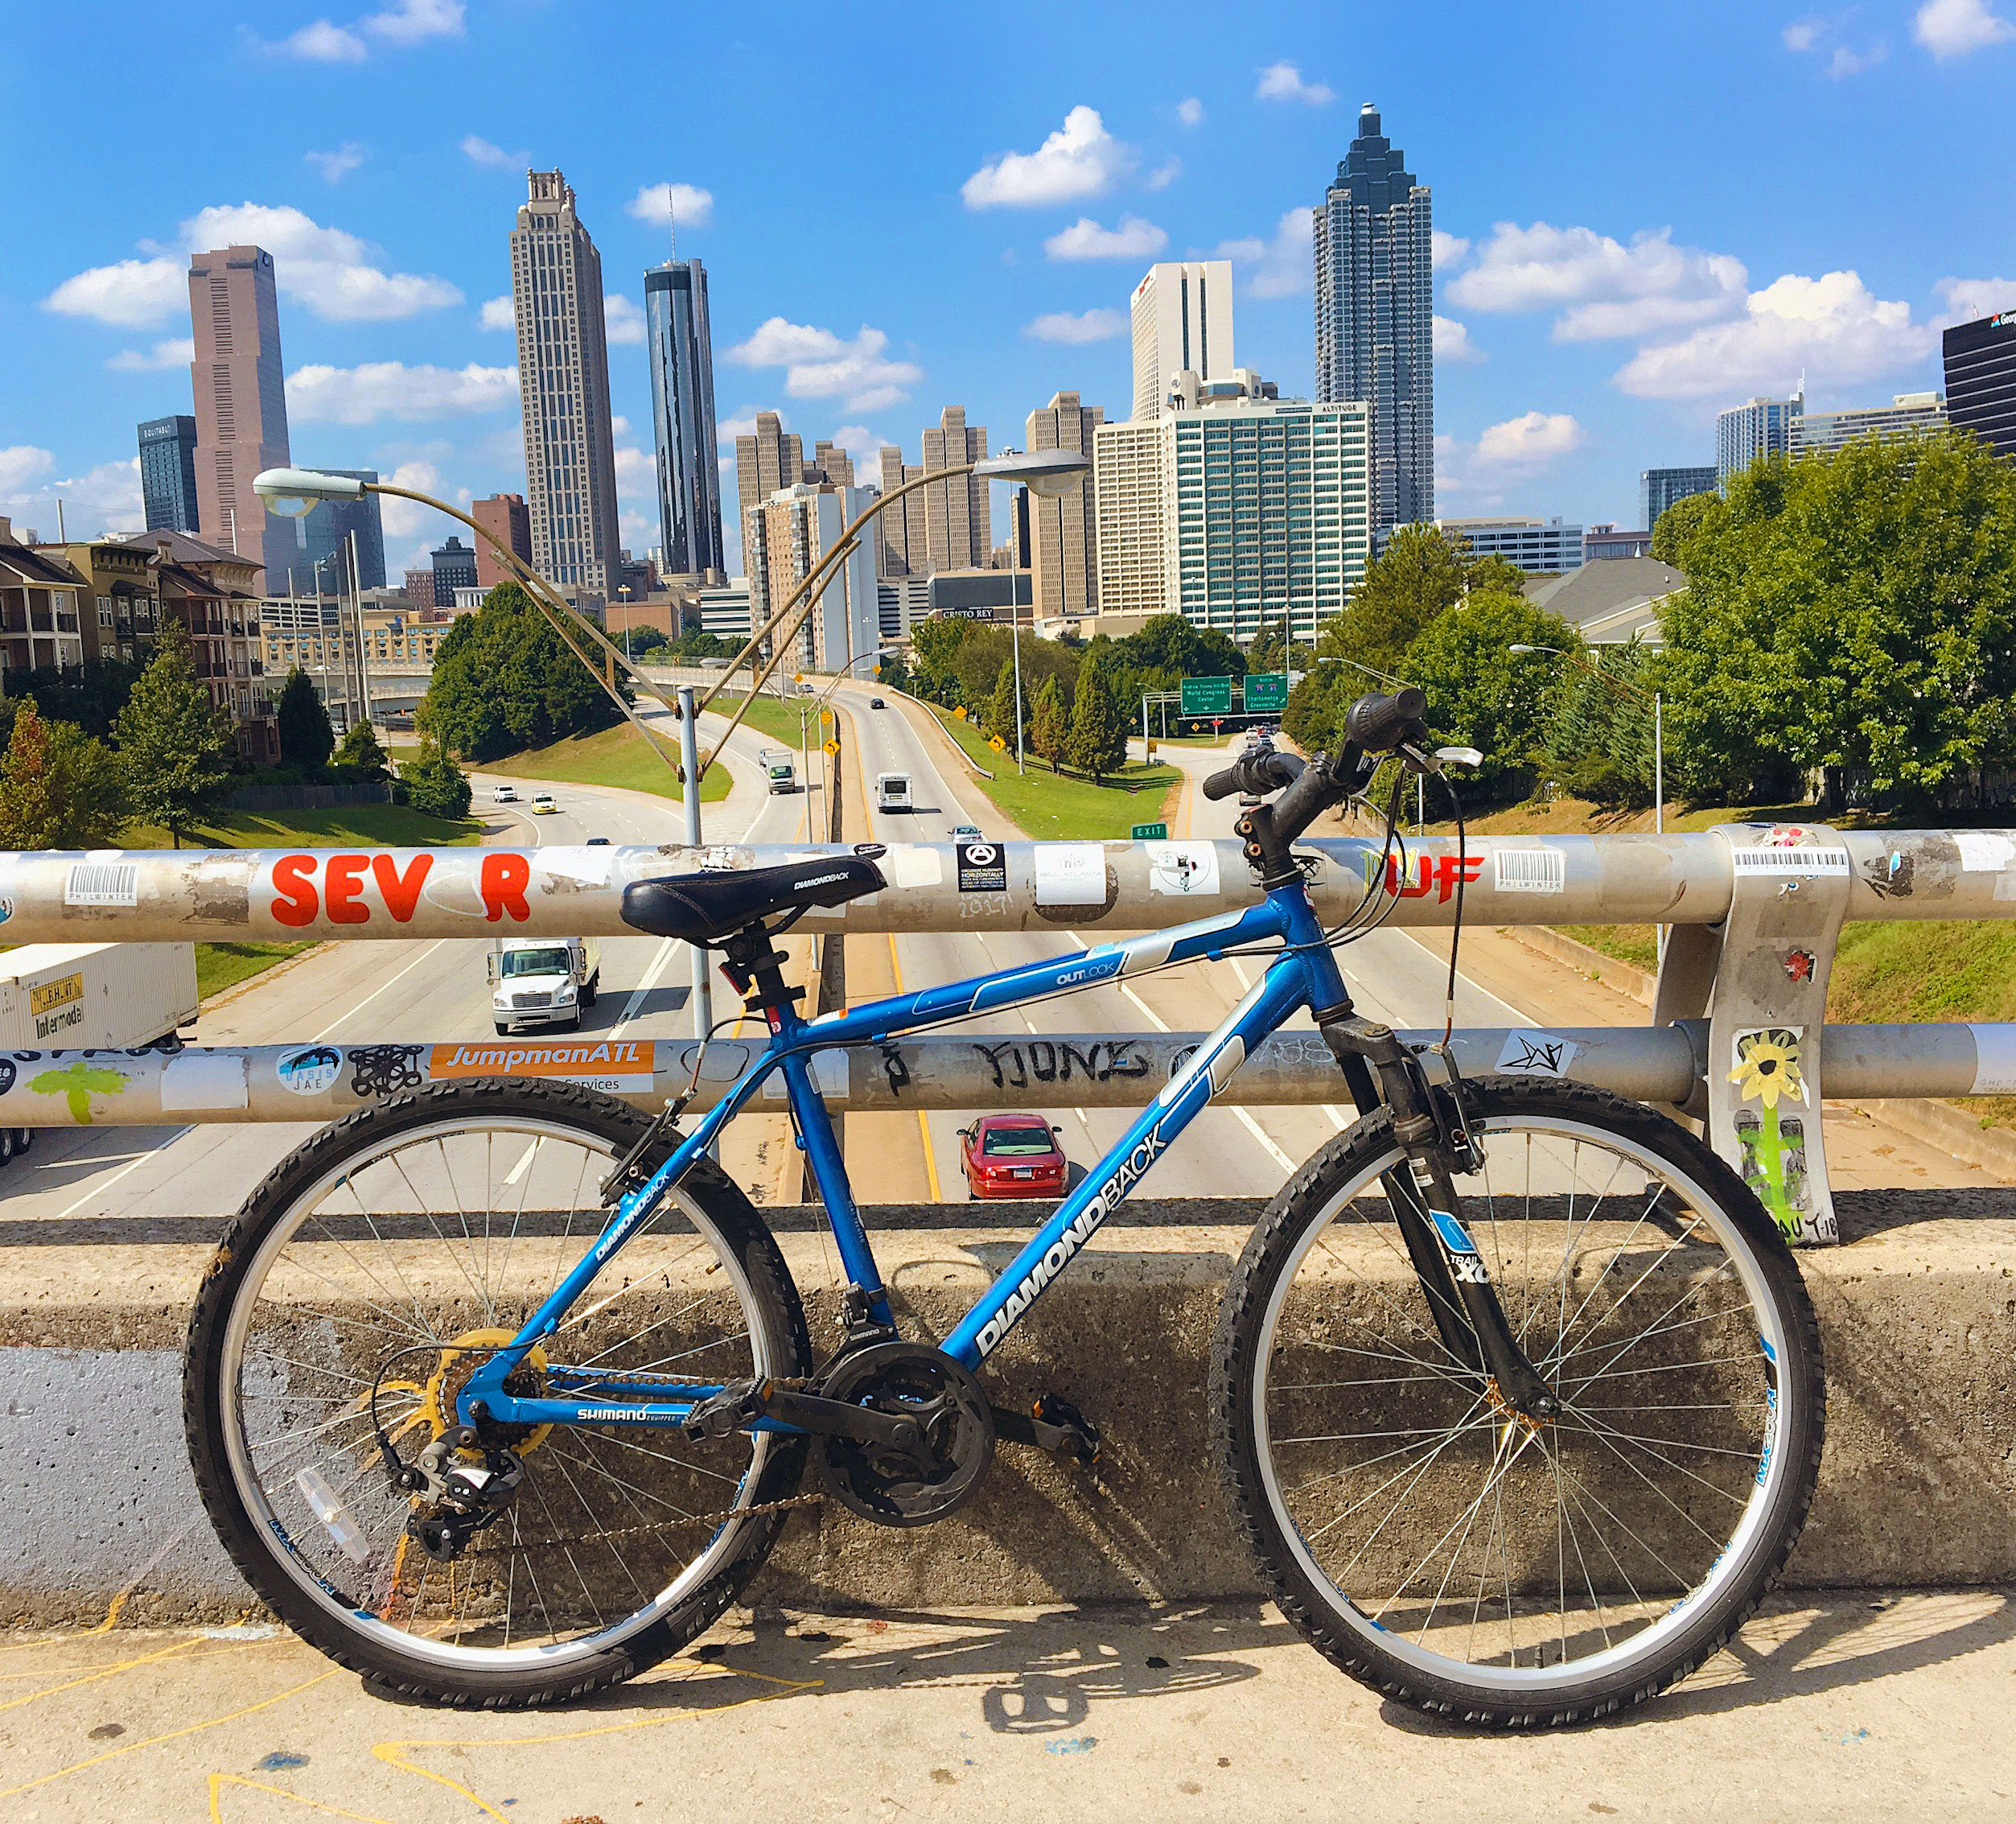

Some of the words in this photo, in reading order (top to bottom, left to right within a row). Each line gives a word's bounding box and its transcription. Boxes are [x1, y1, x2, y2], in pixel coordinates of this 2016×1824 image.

[977, 609, 993, 618] REY
[1137, 826, 1161, 837] EXIT
[793, 871, 850, 890] DIAMONDBACK
[1500, 880, 1561, 889] PHILWINTER
[1056, 962, 1114, 986] OUTLOOK
[446, 1044, 640, 1073] JumpmanATL
[286, 1068, 333, 1082] OASIS
[294, 1079, 322, 1090] JAE
[595, 1169, 670, 1262] DIAMONDBACK
[975, 1123, 1166, 1357] DIAMONDBACK
[1450, 1254, 1479, 1265] TRAIL
[850, 1328, 880, 1341] SHIMANO
[577, 1409, 647, 1421] SHIMANO
